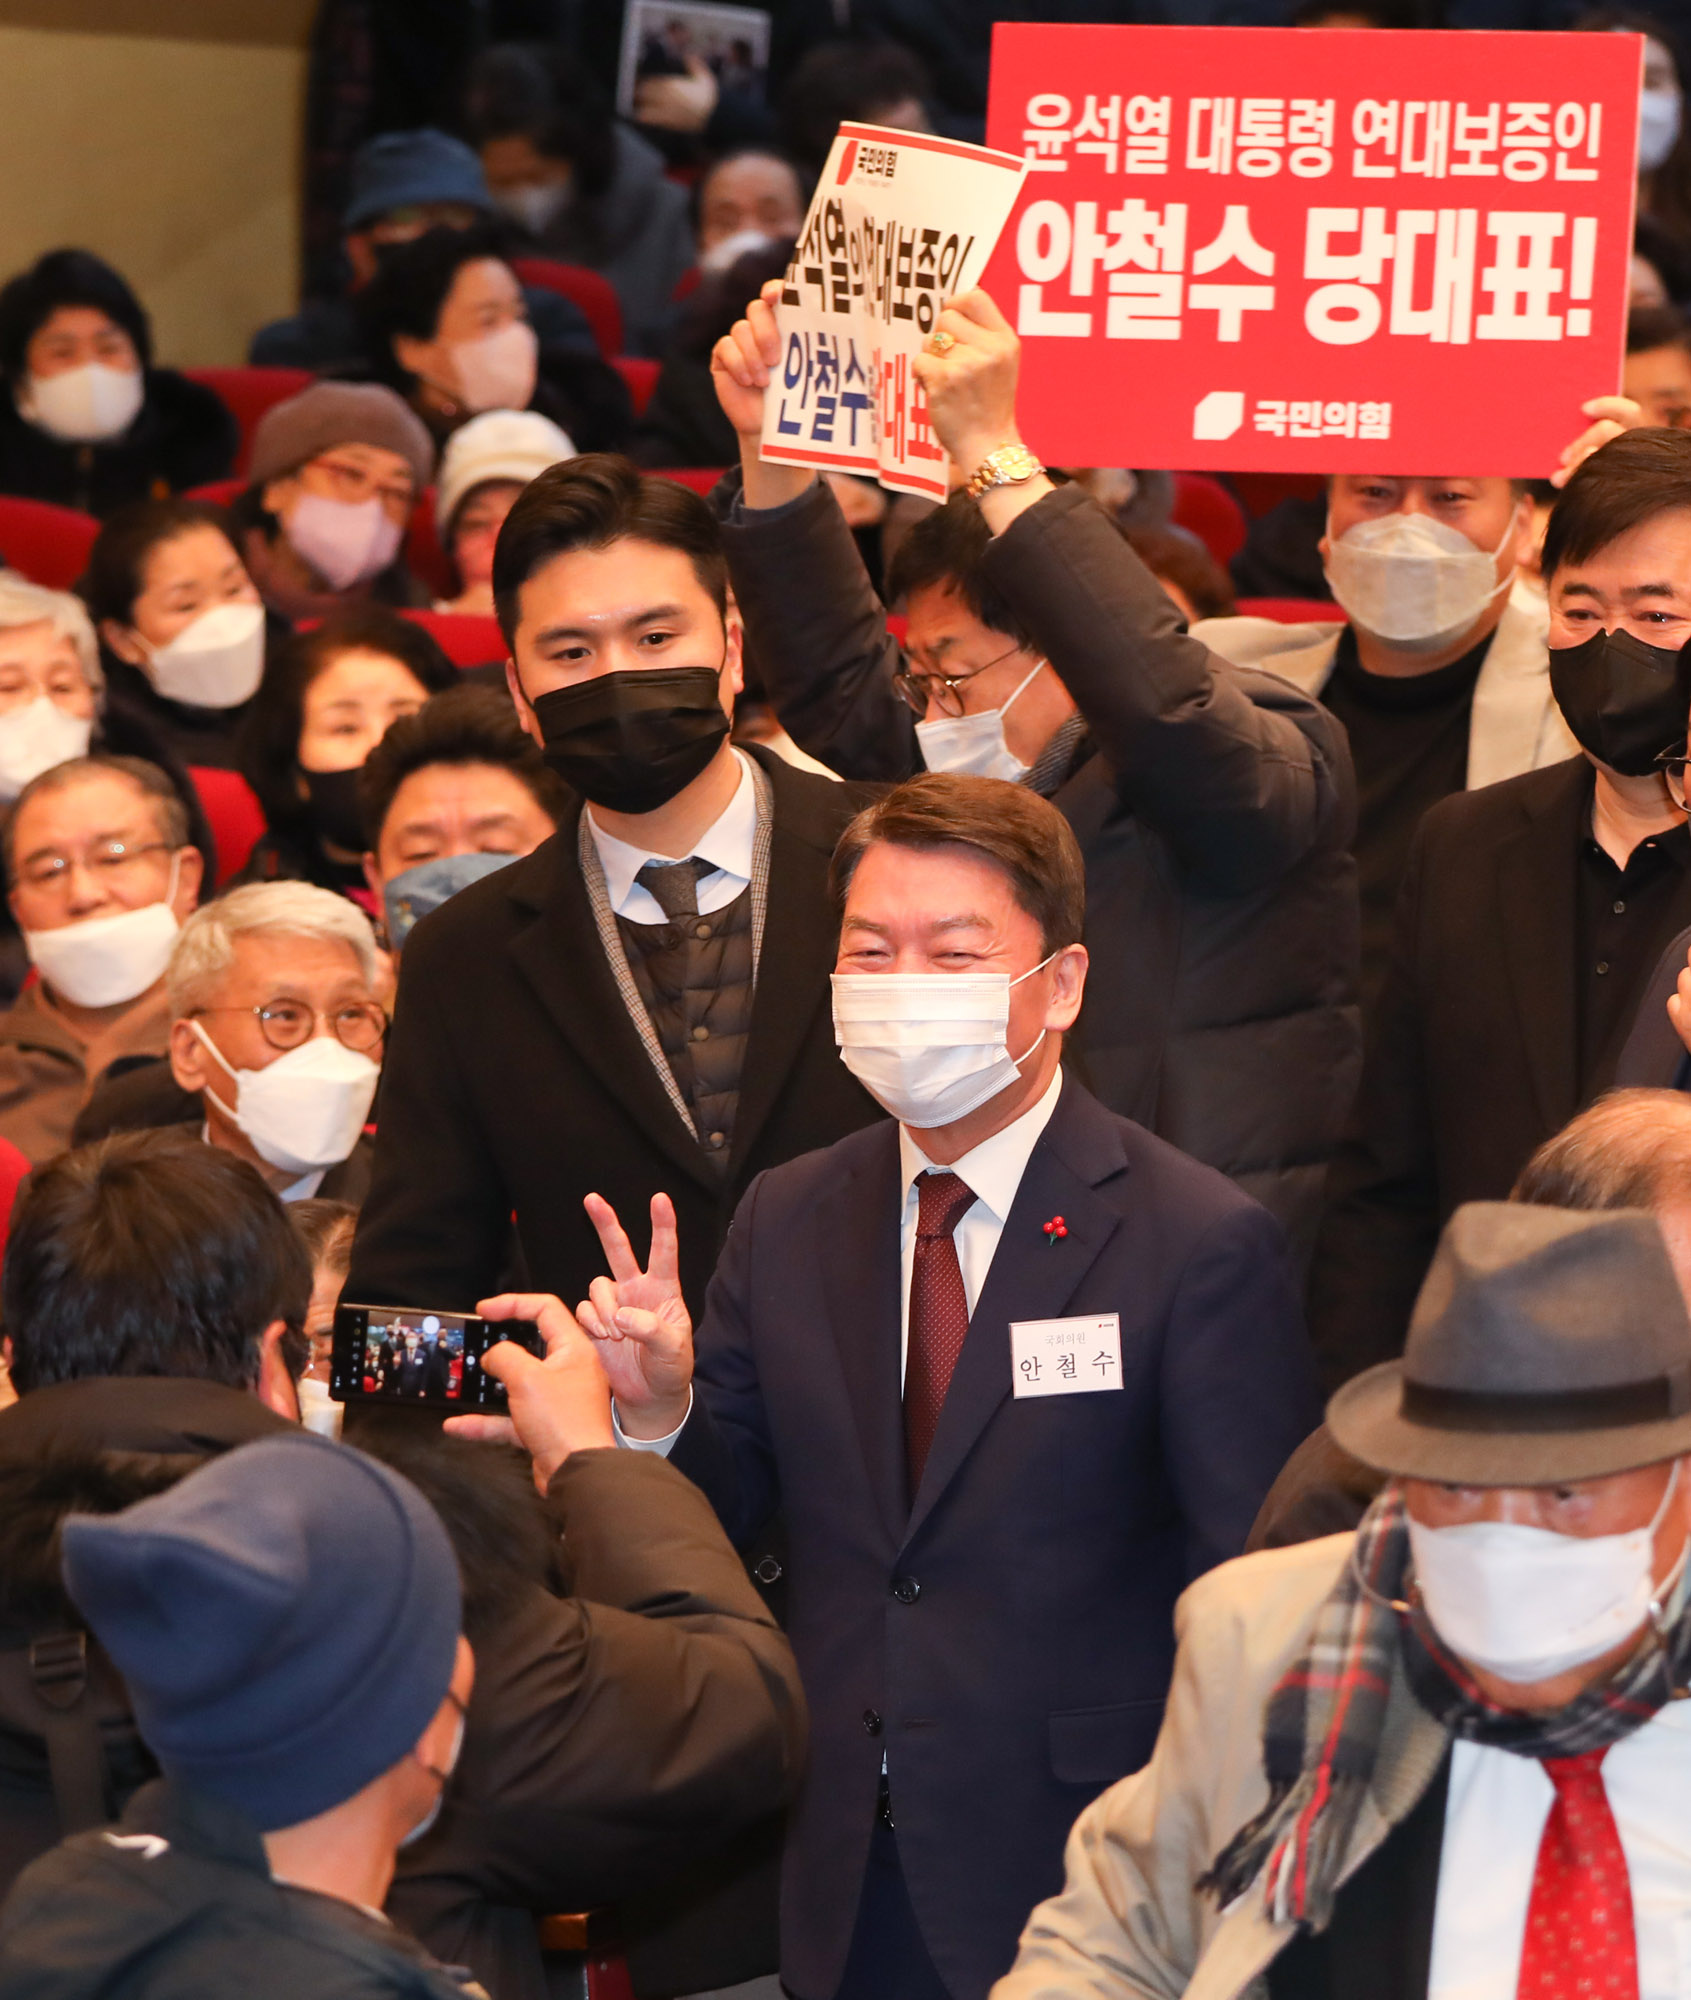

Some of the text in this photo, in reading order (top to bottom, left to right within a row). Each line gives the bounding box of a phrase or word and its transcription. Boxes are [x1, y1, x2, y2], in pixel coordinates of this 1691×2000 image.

[858, 146, 898, 178] 국민의힘
[1022, 93, 1602, 182] 윤석열 대통령 연대보증인
[1015, 198, 1599, 345] 안철수 당대표!
[777, 331, 868, 447] 안철수
[1253, 401, 1391, 440] 국민의힘
[1044, 1331, 1087, 1347] 국회의원
